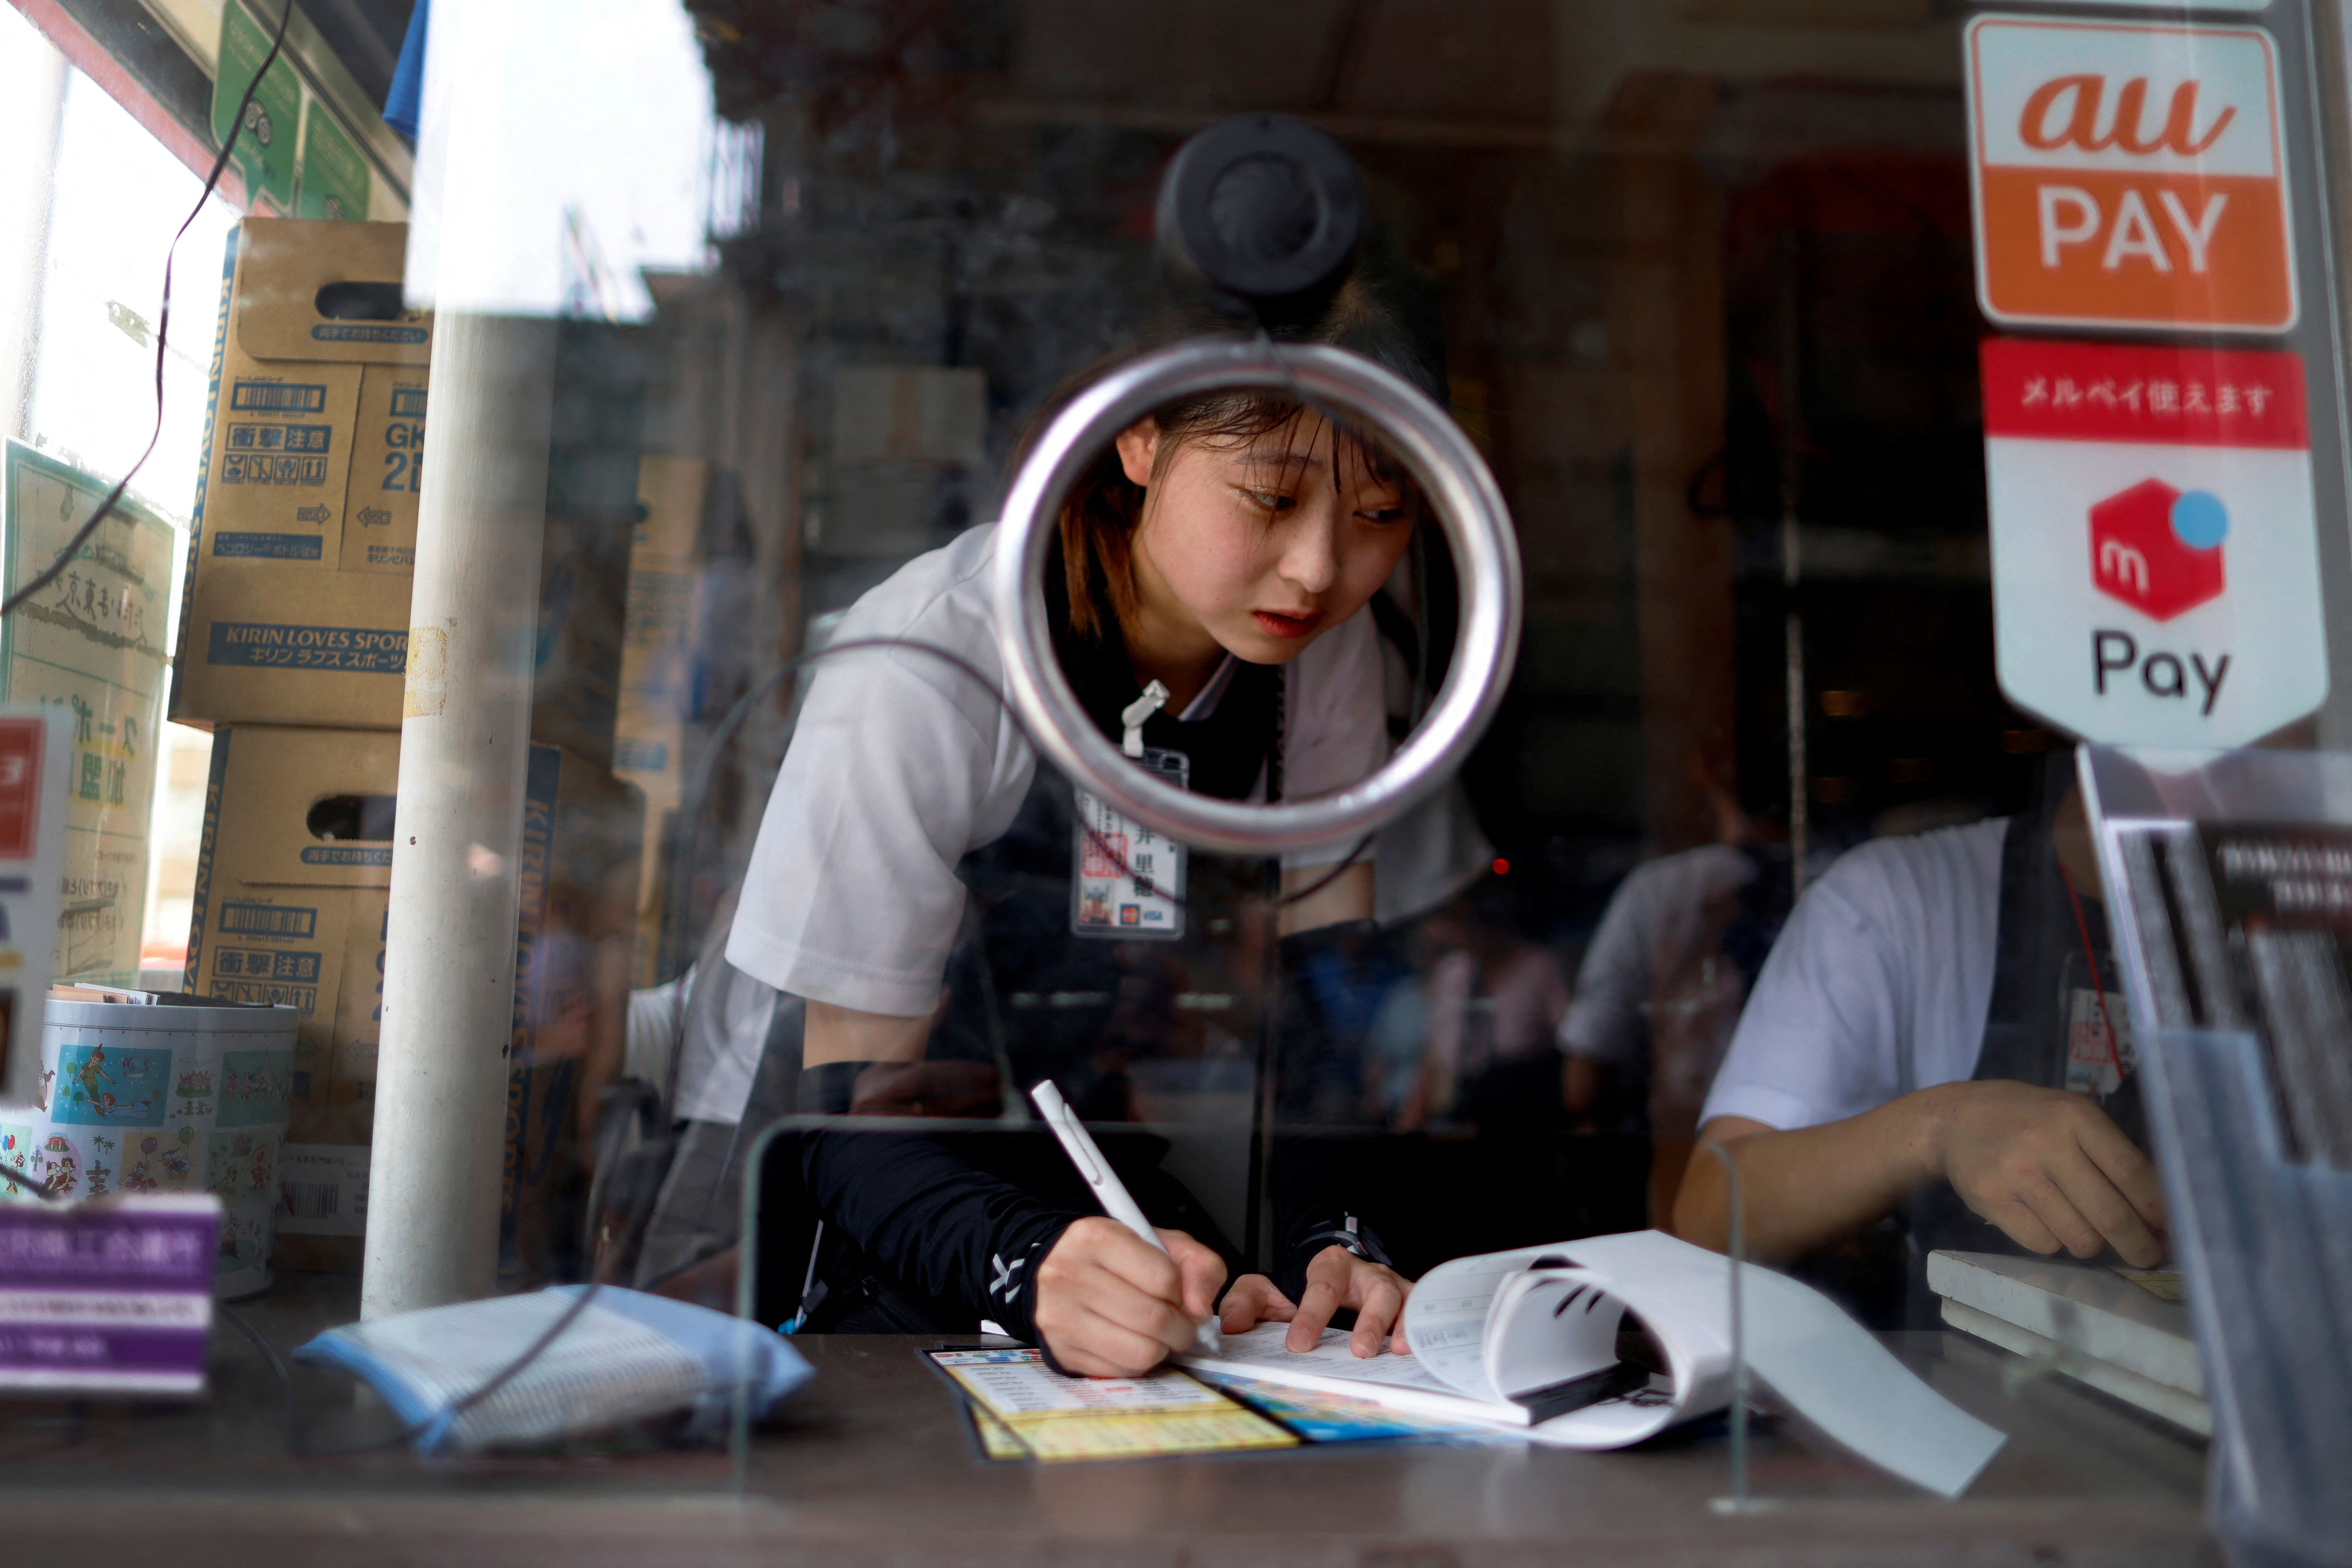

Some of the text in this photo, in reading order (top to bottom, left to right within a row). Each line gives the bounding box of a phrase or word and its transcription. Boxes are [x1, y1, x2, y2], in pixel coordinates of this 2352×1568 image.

[2018, 73, 2238, 157] au
[2037, 186, 2229, 274] PAY
[210, 277, 233, 382] KIRIN
[319, 327, 421, 341] 両手でお持ちください
[2022, 375, 2273, 416] メルペイ使えます
[233, 427, 326, 448] 衝撃注意
[2100, 538, 2149, 597] m
[226, 626, 284, 645] KIRIN
[288, 629, 350, 649] LOVES
[250, 647, 293, 662] キリン
[345, 652, 405, 669] スポーツ
[2091, 629, 2232, 718] Pay
[196, 782, 220, 894] KIRIN
[520, 797, 550, 915] KIRIN
[1143, 911, 1163, 921] VISA
[220, 951, 315, 978] 衝撃注意
